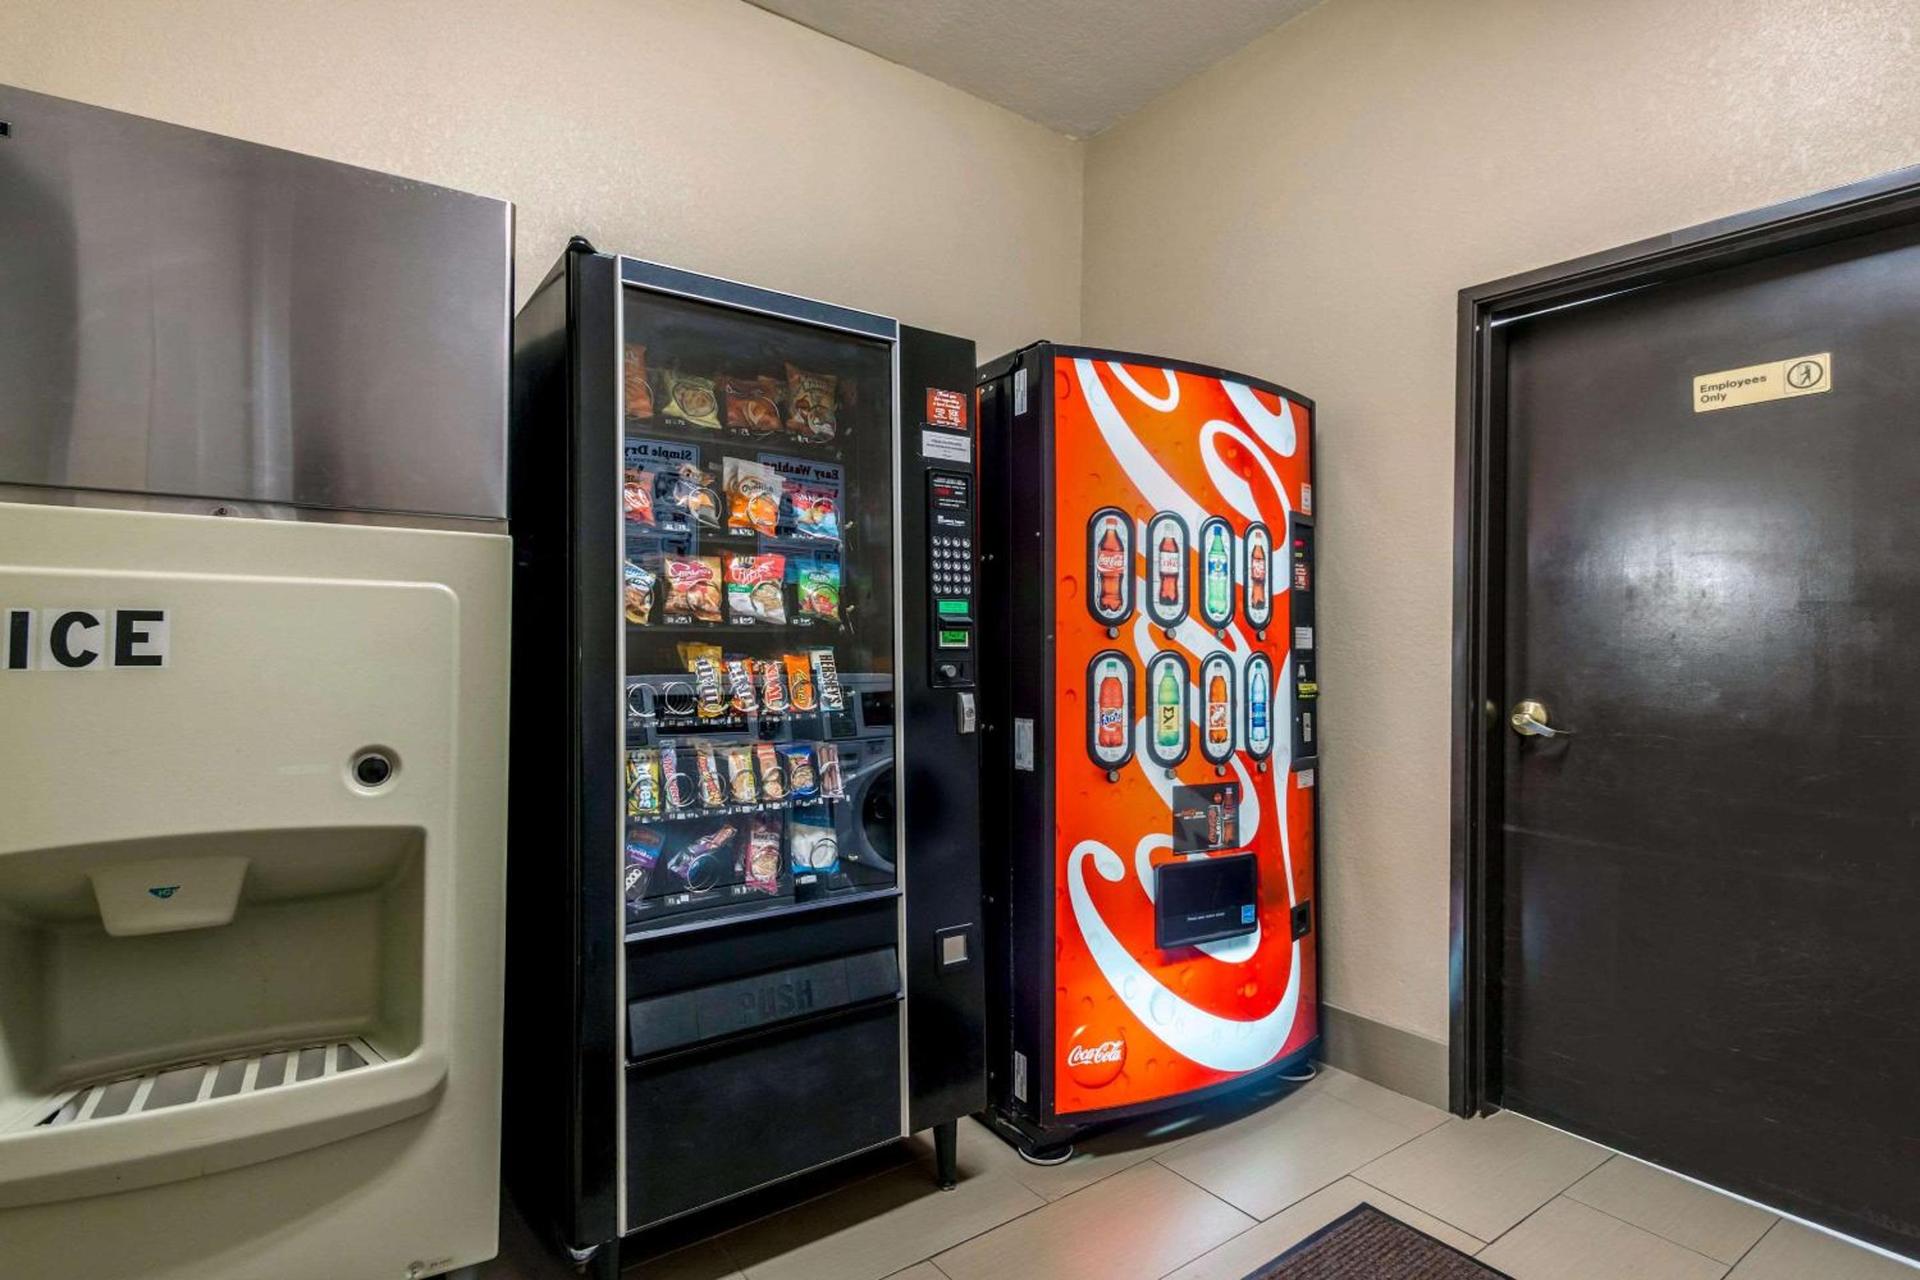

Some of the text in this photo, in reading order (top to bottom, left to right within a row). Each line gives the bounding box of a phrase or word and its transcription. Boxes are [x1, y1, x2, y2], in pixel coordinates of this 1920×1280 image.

[1700, 375, 1767, 393] Employees
[1700, 392, 1727, 404] Only
[8, 610, 164, 669] ICE
